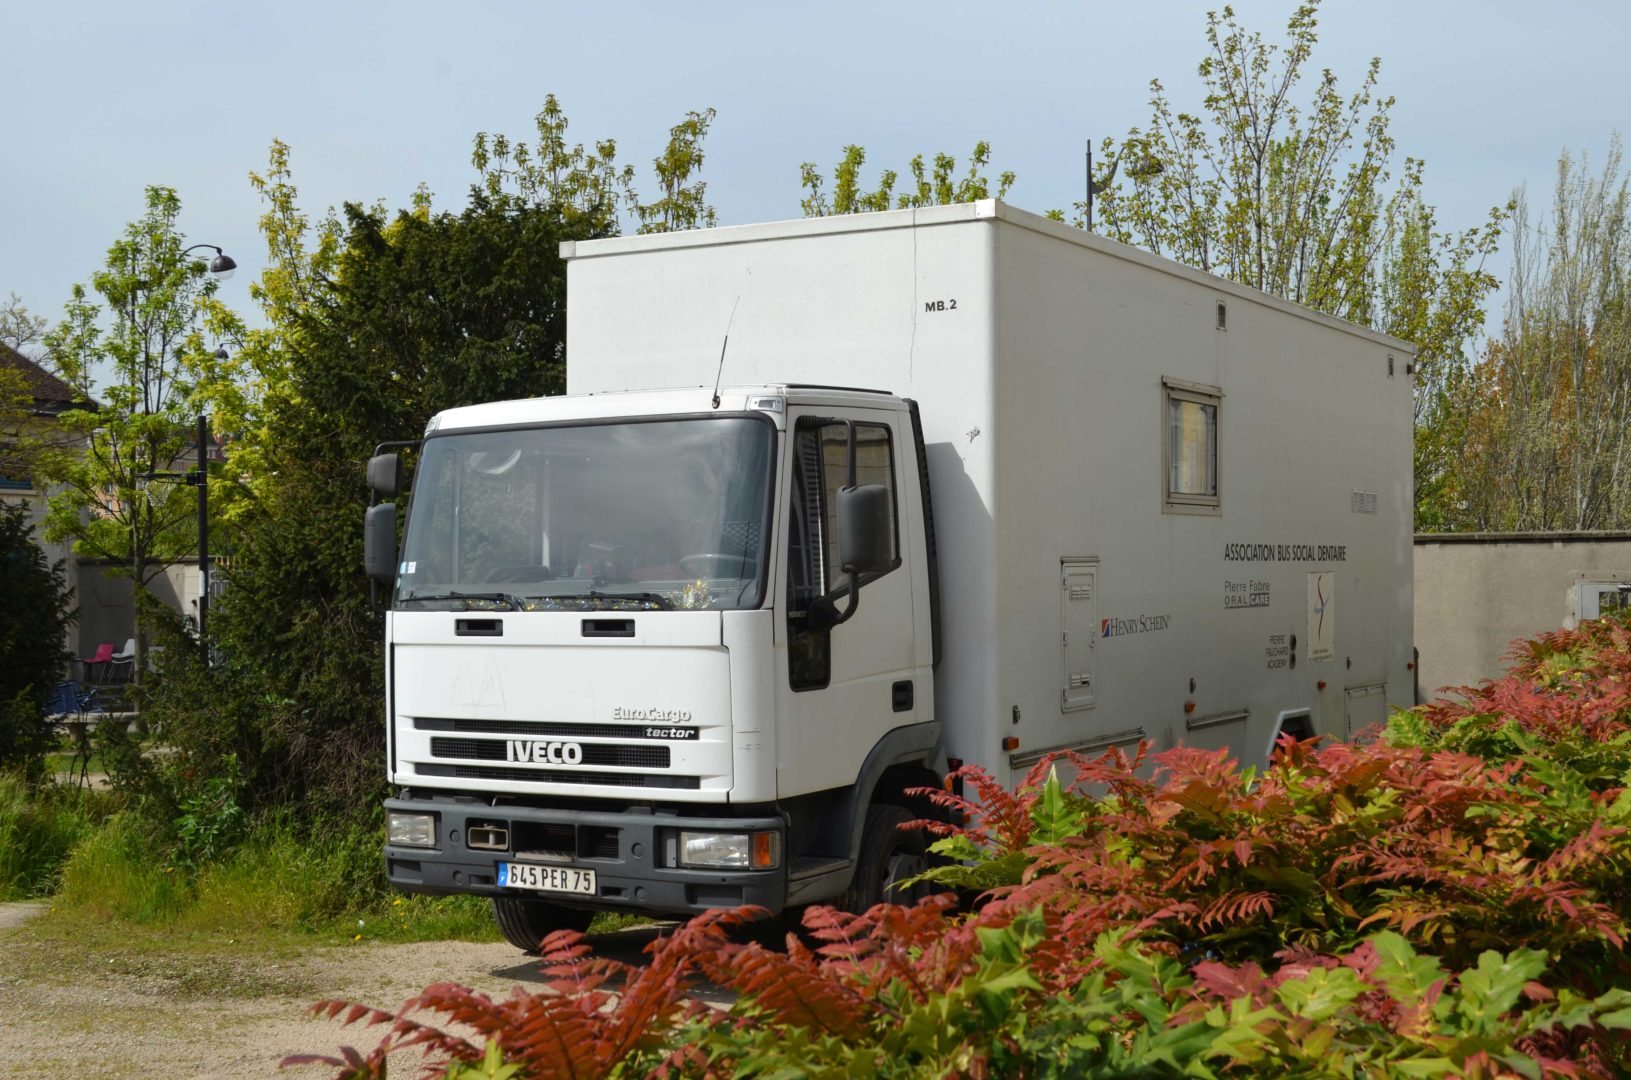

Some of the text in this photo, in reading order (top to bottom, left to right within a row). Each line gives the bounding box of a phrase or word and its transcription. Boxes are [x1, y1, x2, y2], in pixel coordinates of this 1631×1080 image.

[925, 299, 957, 312] MB.2
[1224, 543, 1346, 561] ASSOCIATION BUS SOCIAL DENTAIRE
[1224, 579, 1270, 592] Pierre Fabre
[1224, 594, 1269, 606] ORAL CARE
[612, 706, 692, 722] EuroCargo
[646, 727, 694, 738] tector
[506, 740, 583, 765] IVECO
